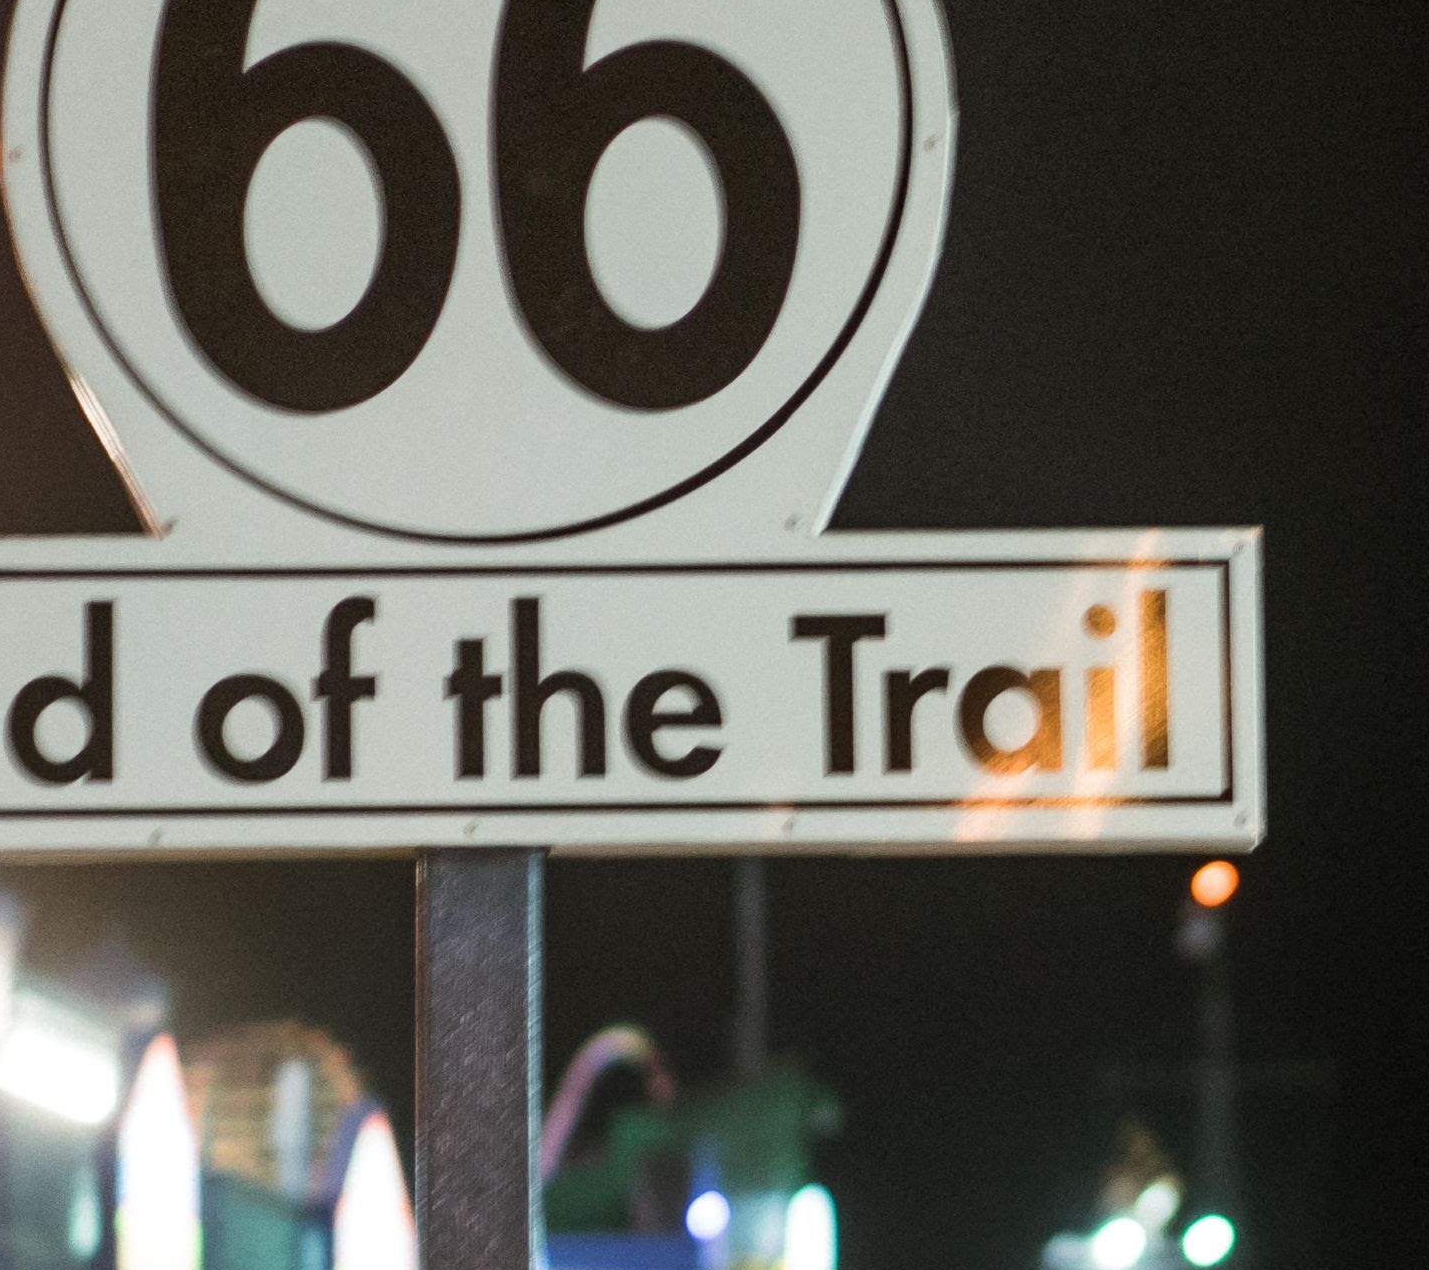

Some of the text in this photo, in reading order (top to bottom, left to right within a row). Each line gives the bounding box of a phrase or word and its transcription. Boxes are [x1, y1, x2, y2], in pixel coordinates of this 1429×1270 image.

[194, 595, 378, 785] of
[445, 595, 724, 781] the
[790, 587, 1171, 777] Trail
